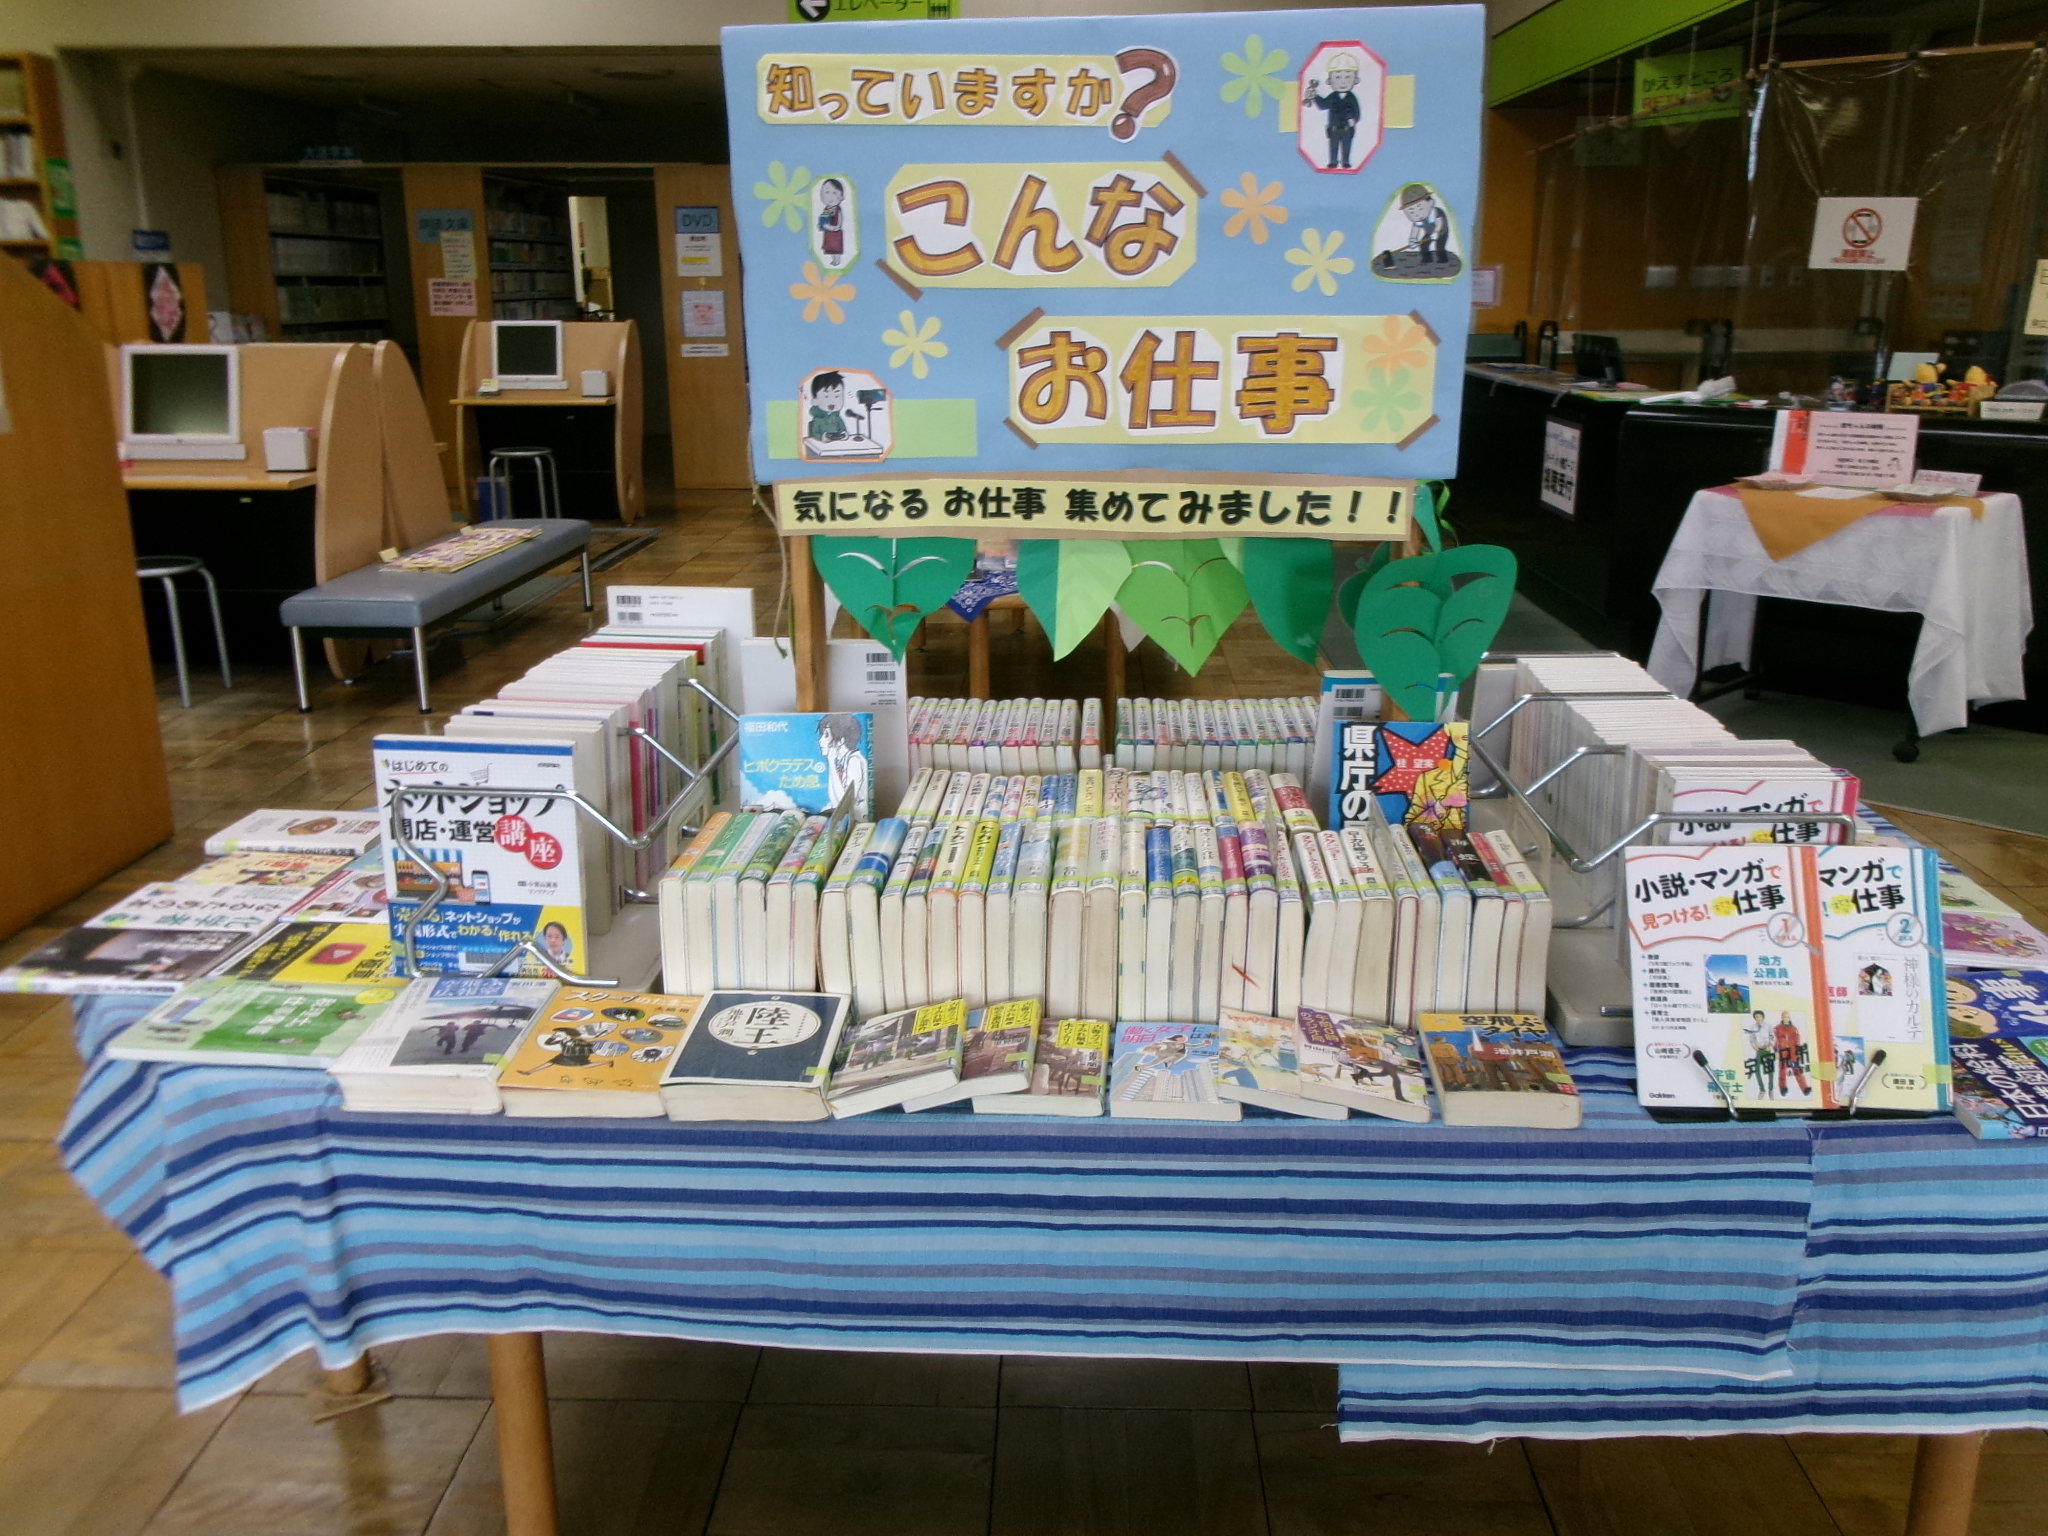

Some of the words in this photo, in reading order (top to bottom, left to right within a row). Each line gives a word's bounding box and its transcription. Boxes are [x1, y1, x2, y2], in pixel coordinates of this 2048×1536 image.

[765, 48, 1178, 140] 知っていますか？
[682, 214, 713, 228] DVD
[893, 174, 1185, 278] こんな
[1016, 329, 1339, 435] お仕事
[793, 487, 929, 524] 気になる
[944, 487, 1047, 521] お仕事
[1065, 489, 1402, 525] 集めてみました！！
[391, 760, 448, 773] はじめての
[743, 757, 826, 774] ヒポクラテスの
[1634, 858, 1782, 903] 小説・マンガで
[1731, 884, 1786, 915] 仕事
[1851, 884, 1905, 914] 仕事
[1641, 904, 1712, 931] 見つける！
[1899, 918, 1911, 933] 2
[1753, 967, 1790, 980] 公務員
[1758, 955, 1783, 967] 地方
[733, 1007, 792, 1044] 陸王
[1458, 1014, 1543, 1027] 空飛ぶ
[1482, 1025, 1547, 1038] タイヤ
